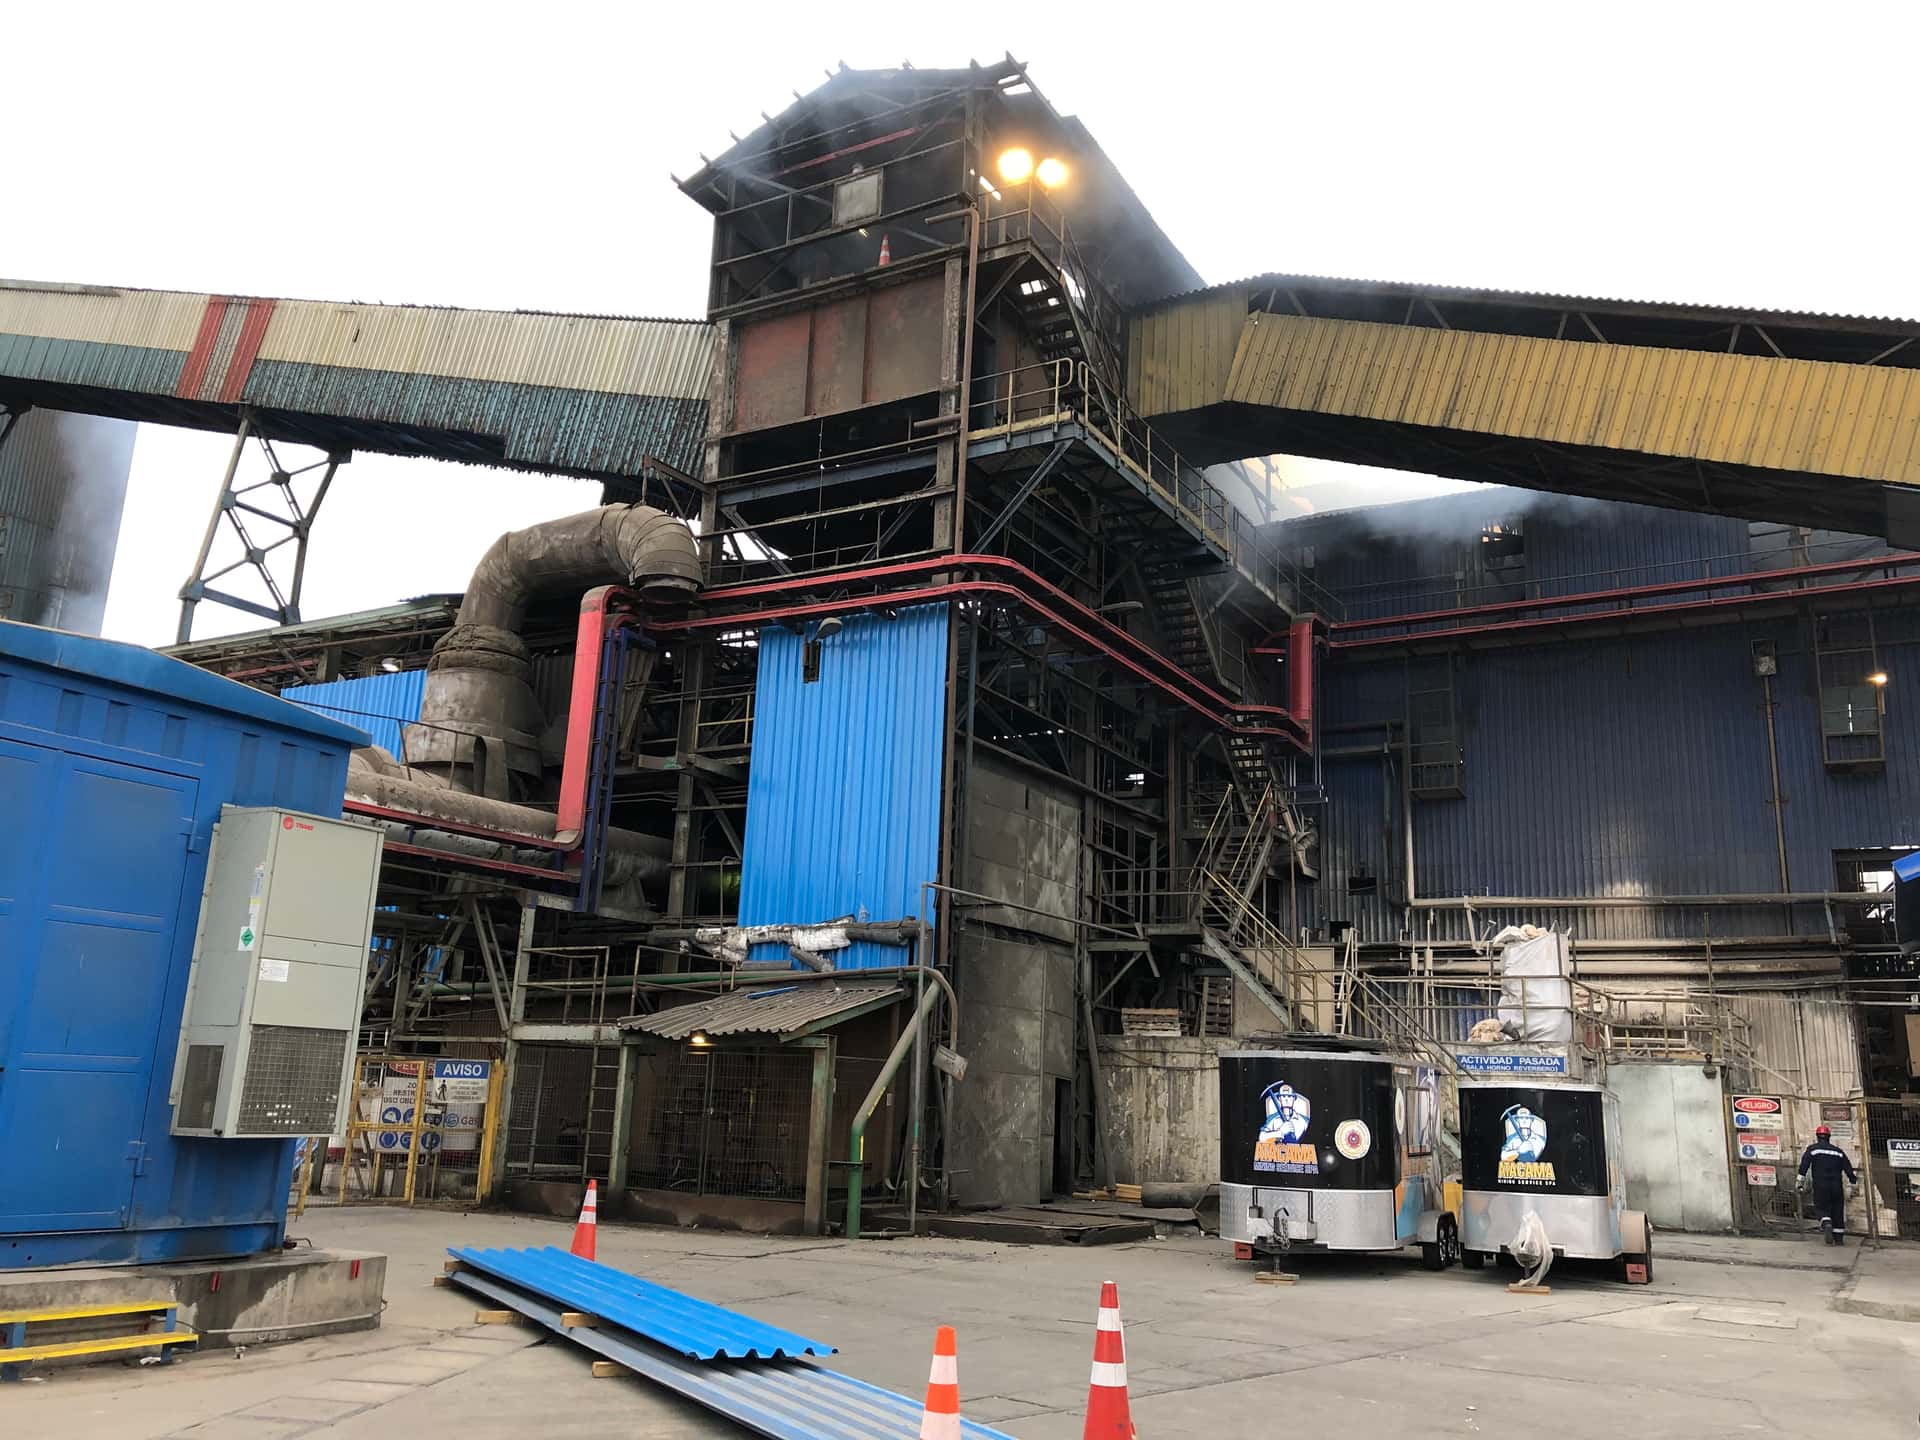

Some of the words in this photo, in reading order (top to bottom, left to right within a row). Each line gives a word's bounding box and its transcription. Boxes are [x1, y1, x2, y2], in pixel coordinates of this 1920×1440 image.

[1460, 1056, 1513, 1065] ACTIVIDAD
[1519, 1057, 1561, 1066] PASADA
[443, 1063, 482, 1076] AVISO
[1741, 1101, 1773, 1110] PELIGRO
[1254, 1142, 1318, 1165] ATACAMA
[1498, 1161, 1556, 1180] ATACAMA
